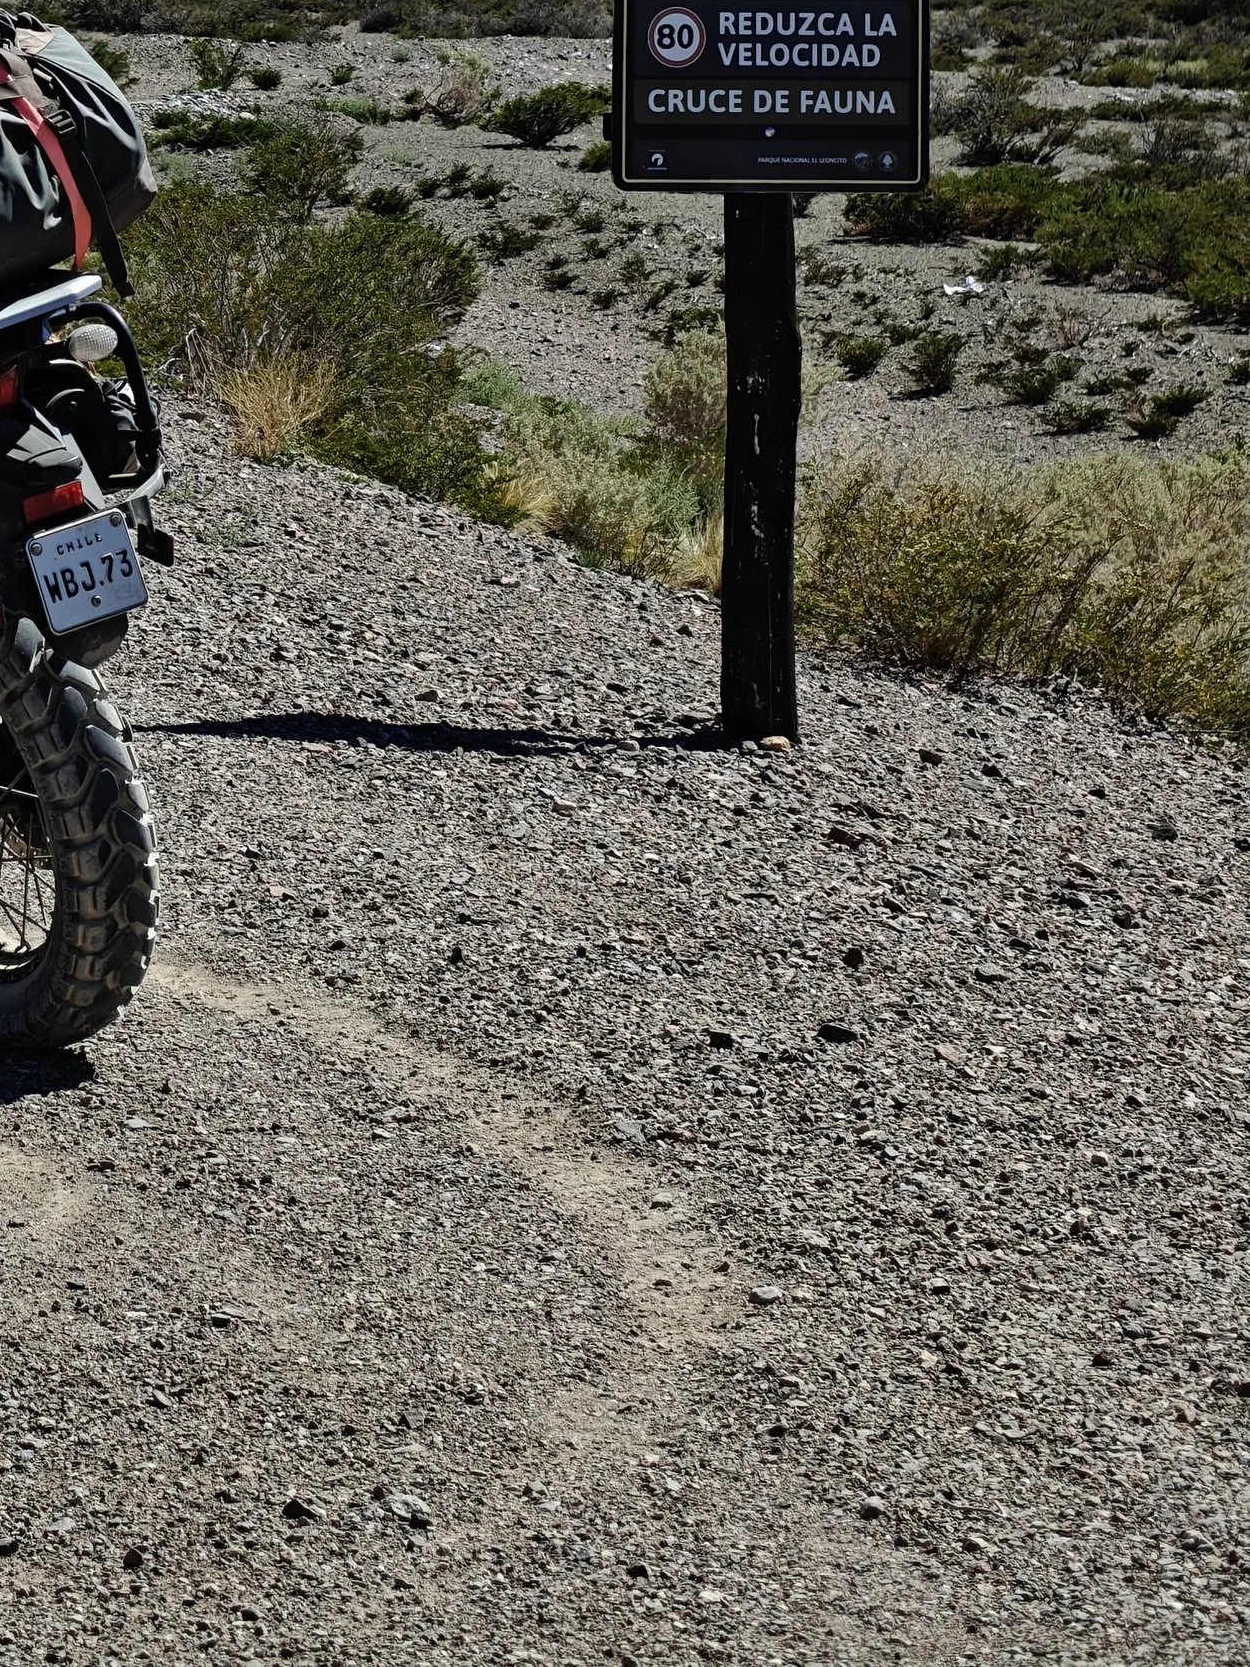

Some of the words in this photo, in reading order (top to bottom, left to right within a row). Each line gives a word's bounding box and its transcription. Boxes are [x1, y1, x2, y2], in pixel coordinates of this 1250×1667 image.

[656, 23, 695, 50] 80
[718, 11, 854, 36] REDUZCA
[864, 13, 897, 37] LA
[717, 42, 881, 67] VELOCIDAD
[647, 89, 743, 113] CRUCE
[753, 90, 790, 113] DE
[800, 90, 896, 114] FAUNA
[56, 533, 103, 555] CHILE
[43, 549, 133, 603] WBJ.73
